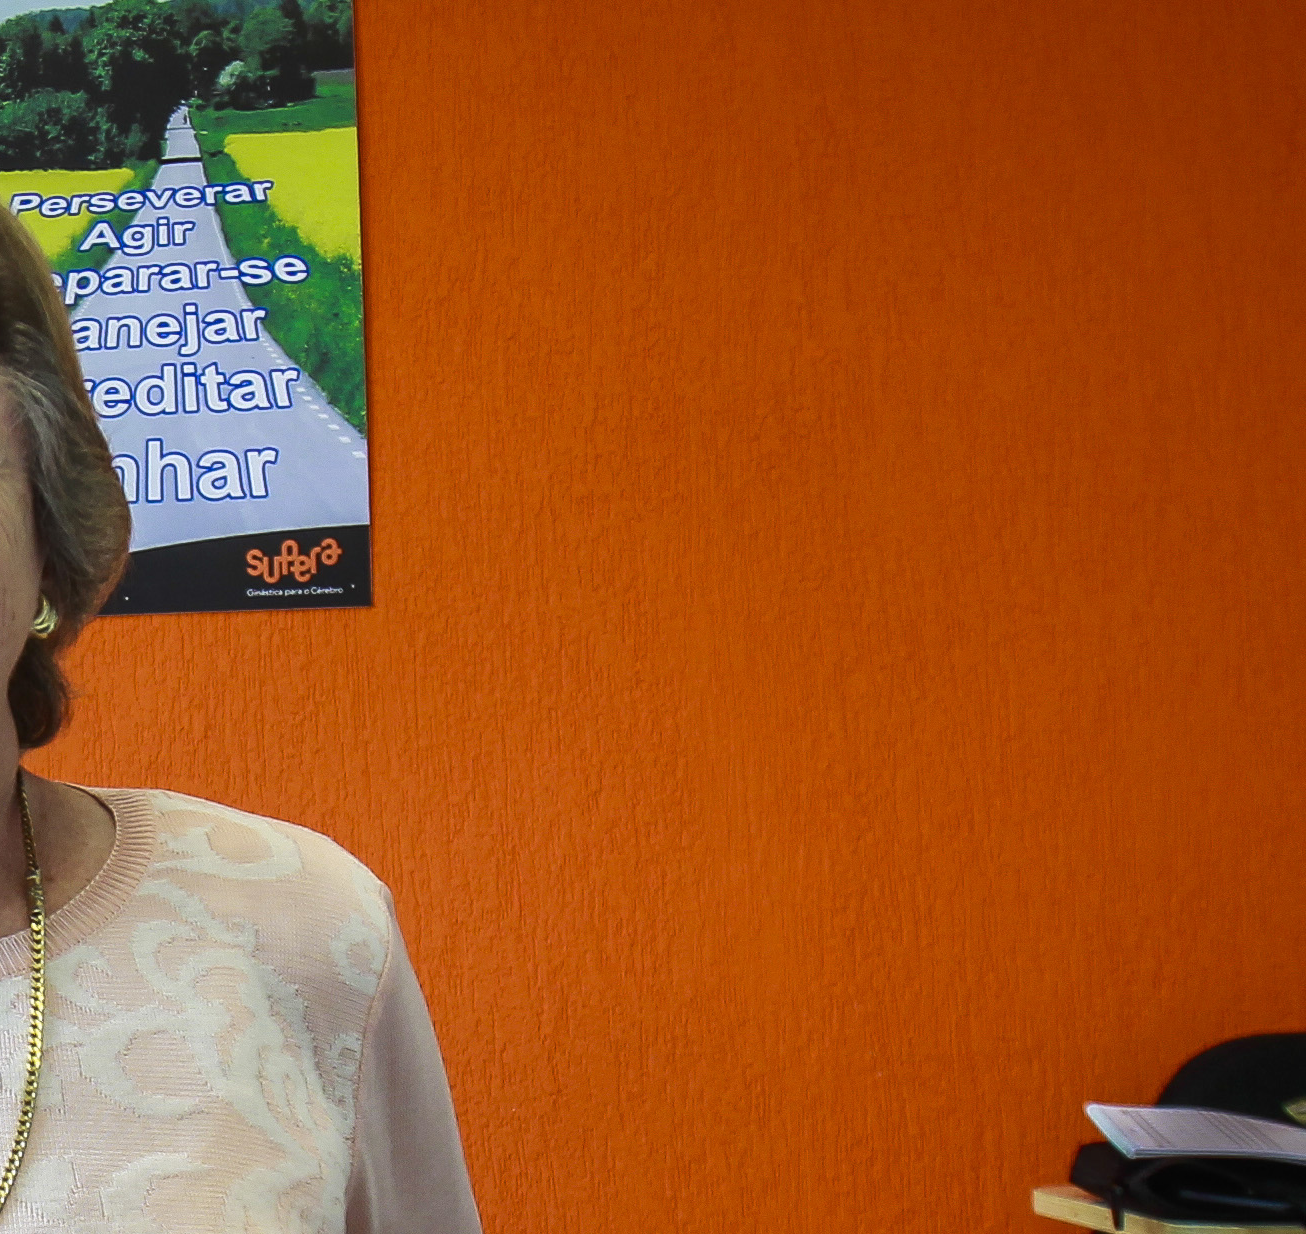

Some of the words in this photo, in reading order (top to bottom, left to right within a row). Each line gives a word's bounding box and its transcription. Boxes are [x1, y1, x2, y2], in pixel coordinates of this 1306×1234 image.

[10, 180, 273, 217] Perseverar
[80, 217, 194, 255] Agir
[71, 303, 267, 355] anejar
[83, 362, 299, 417] editar
[111, 438, 278, 503] nhar
